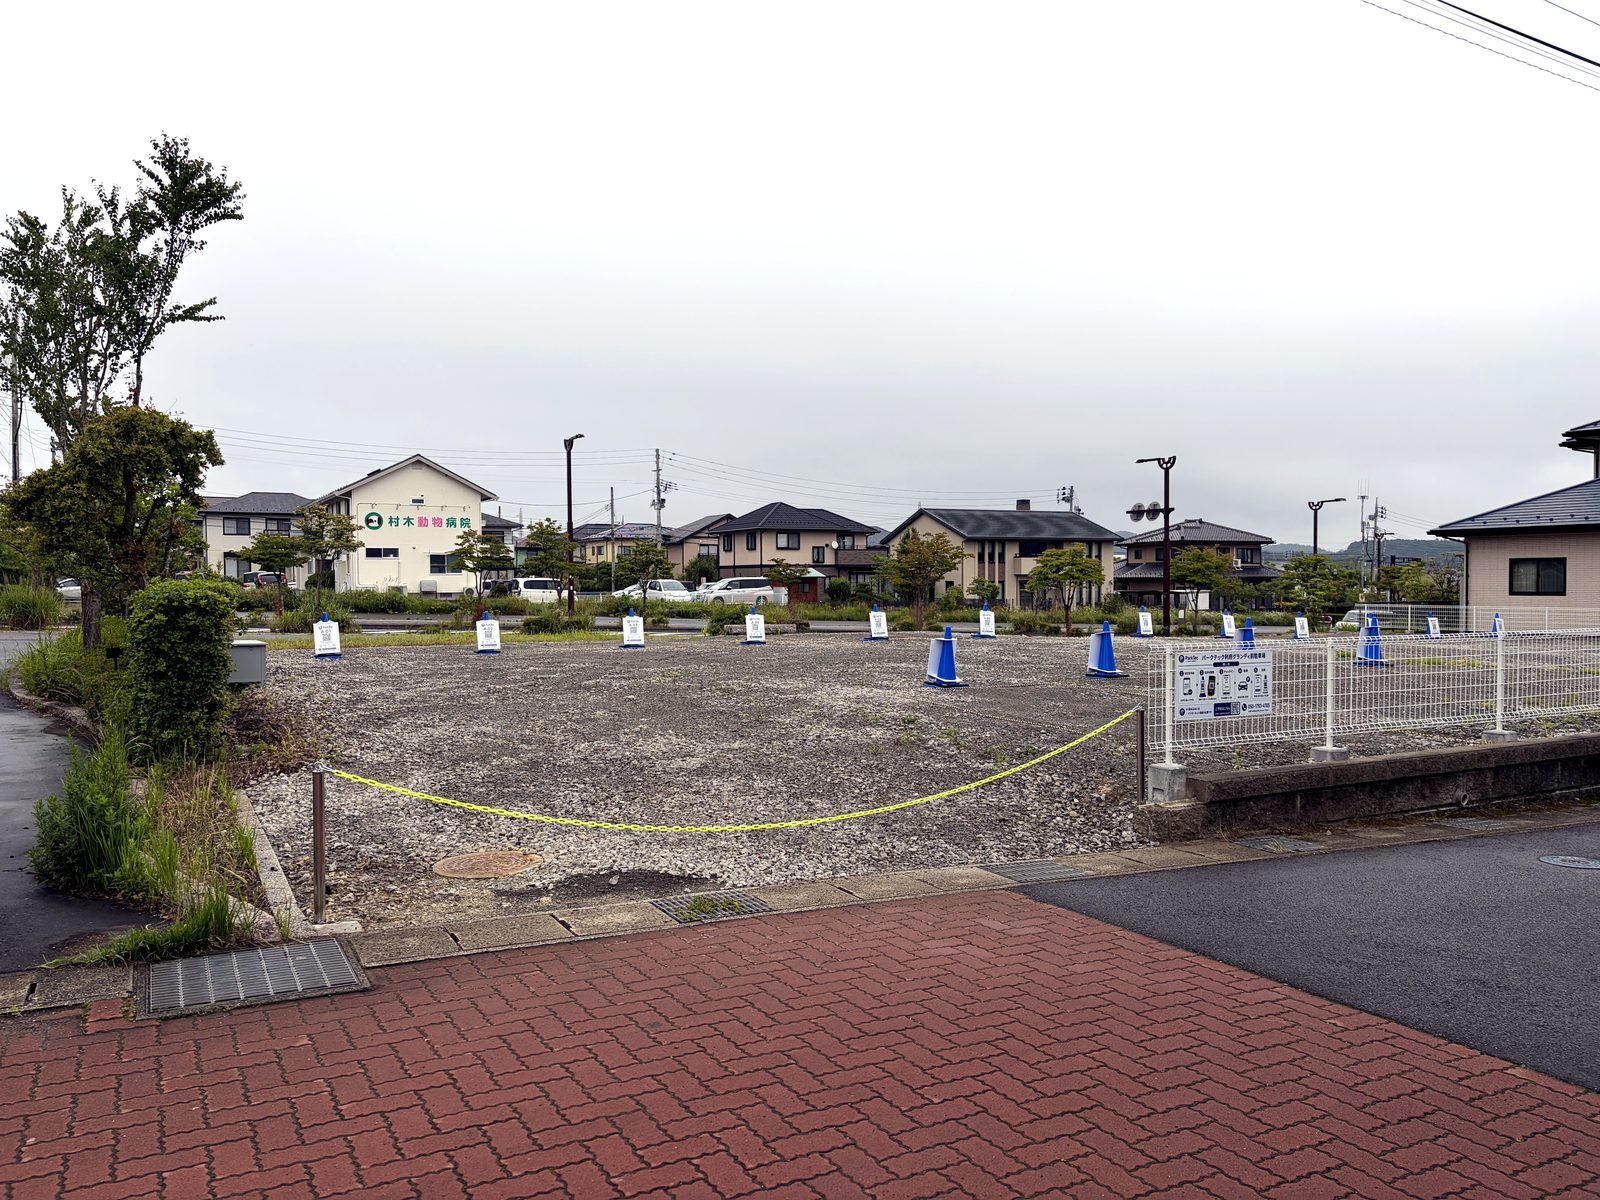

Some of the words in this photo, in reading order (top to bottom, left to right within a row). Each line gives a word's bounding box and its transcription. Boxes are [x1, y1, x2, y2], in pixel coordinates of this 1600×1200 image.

[388, 515, 471, 529] 村木動物病院
